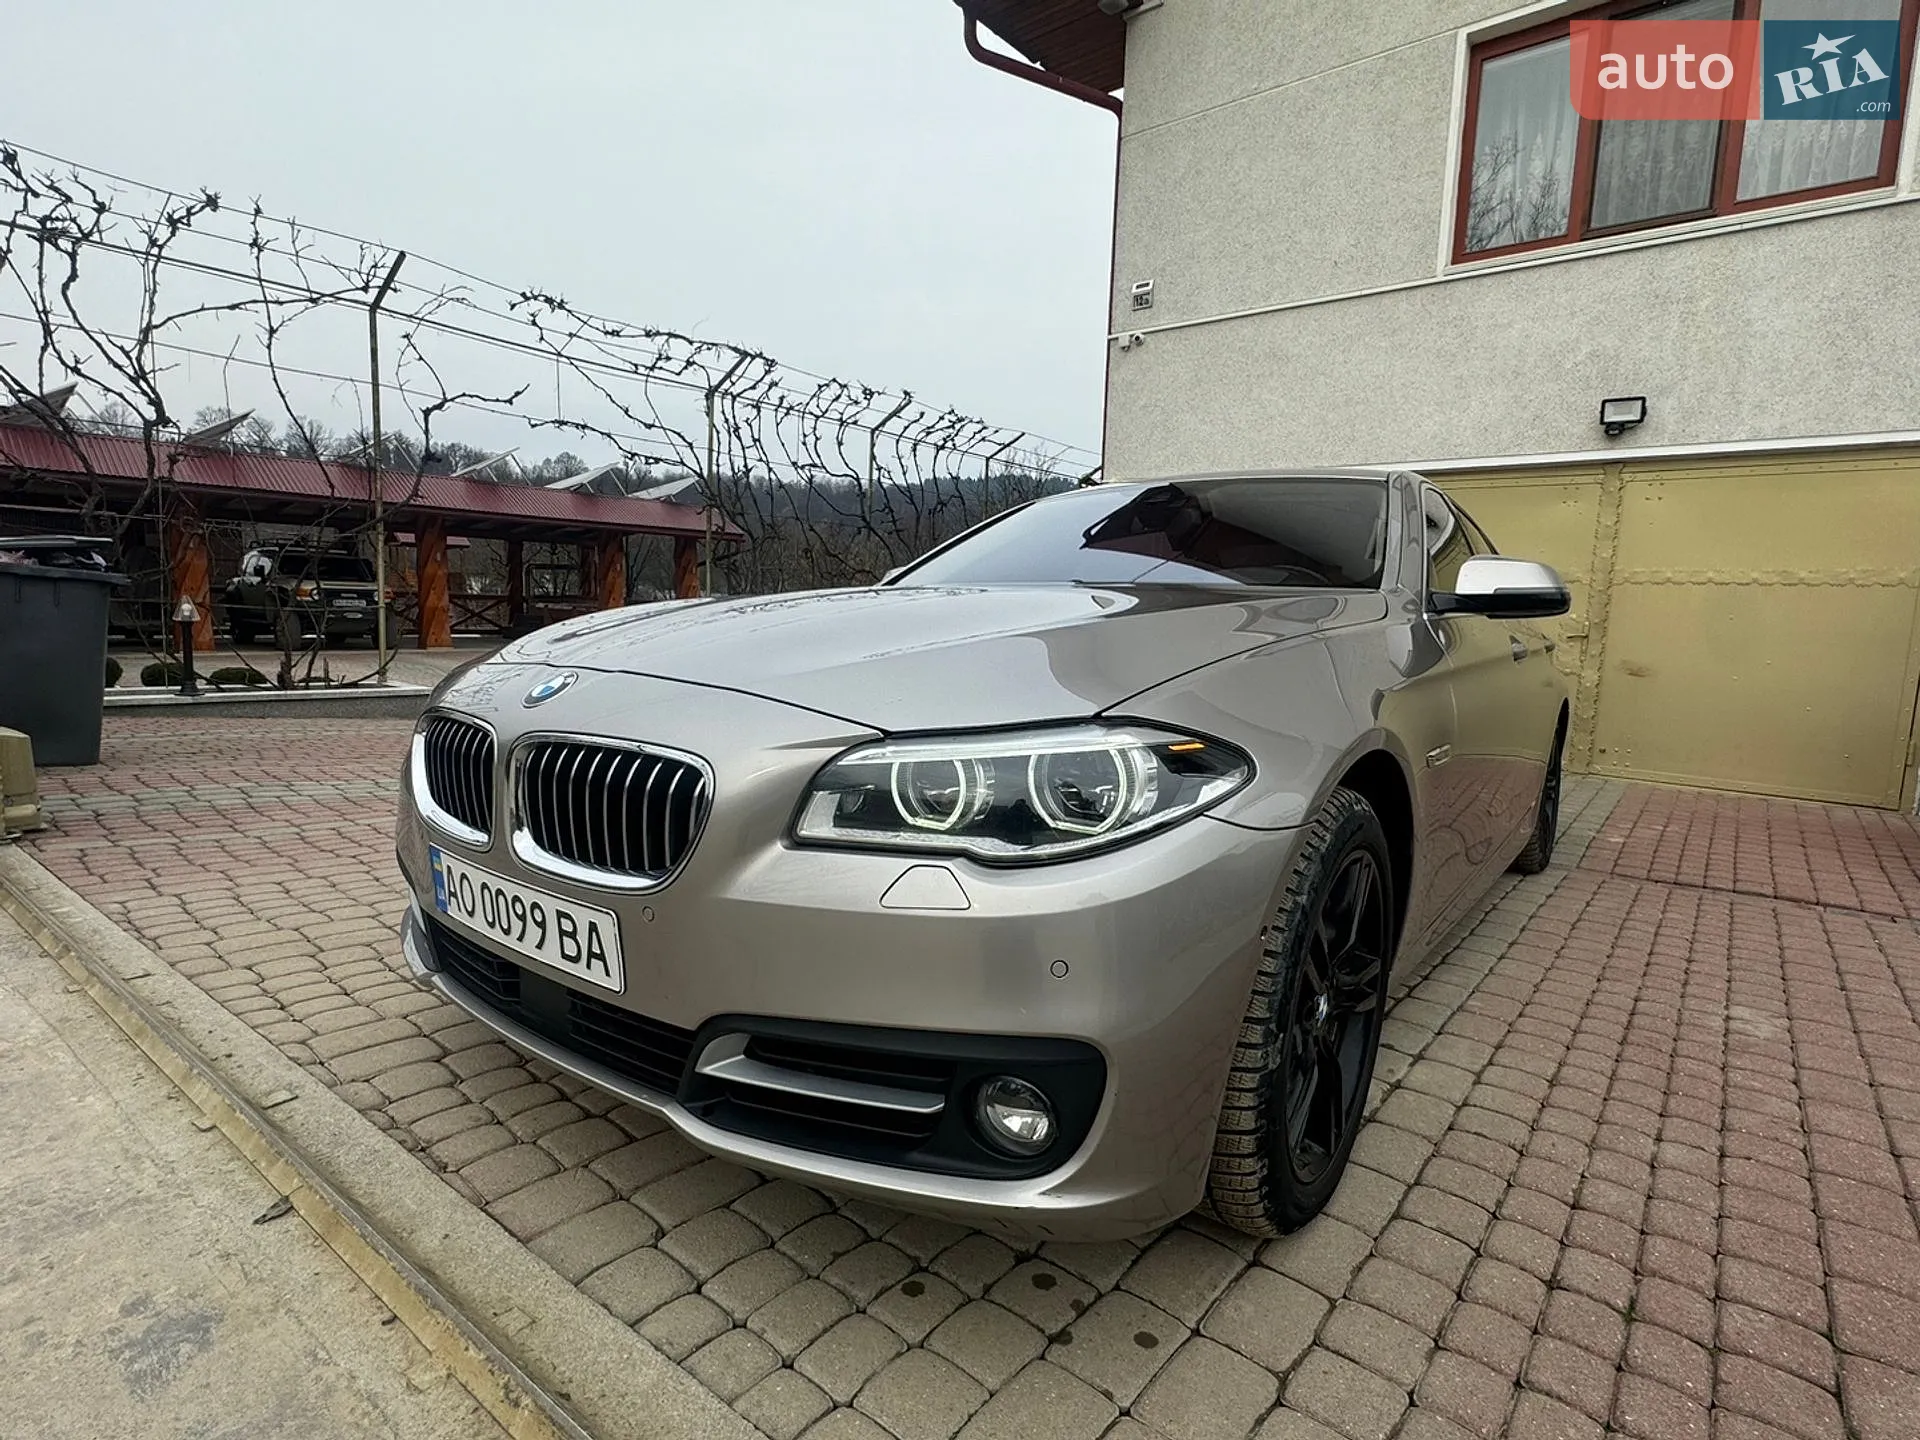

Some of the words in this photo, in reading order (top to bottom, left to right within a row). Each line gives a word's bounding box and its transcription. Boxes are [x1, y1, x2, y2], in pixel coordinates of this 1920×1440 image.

[446, 865, 476, 918] AO
[481, 881, 547, 950] 0099
[556, 909, 611, 978] BA
